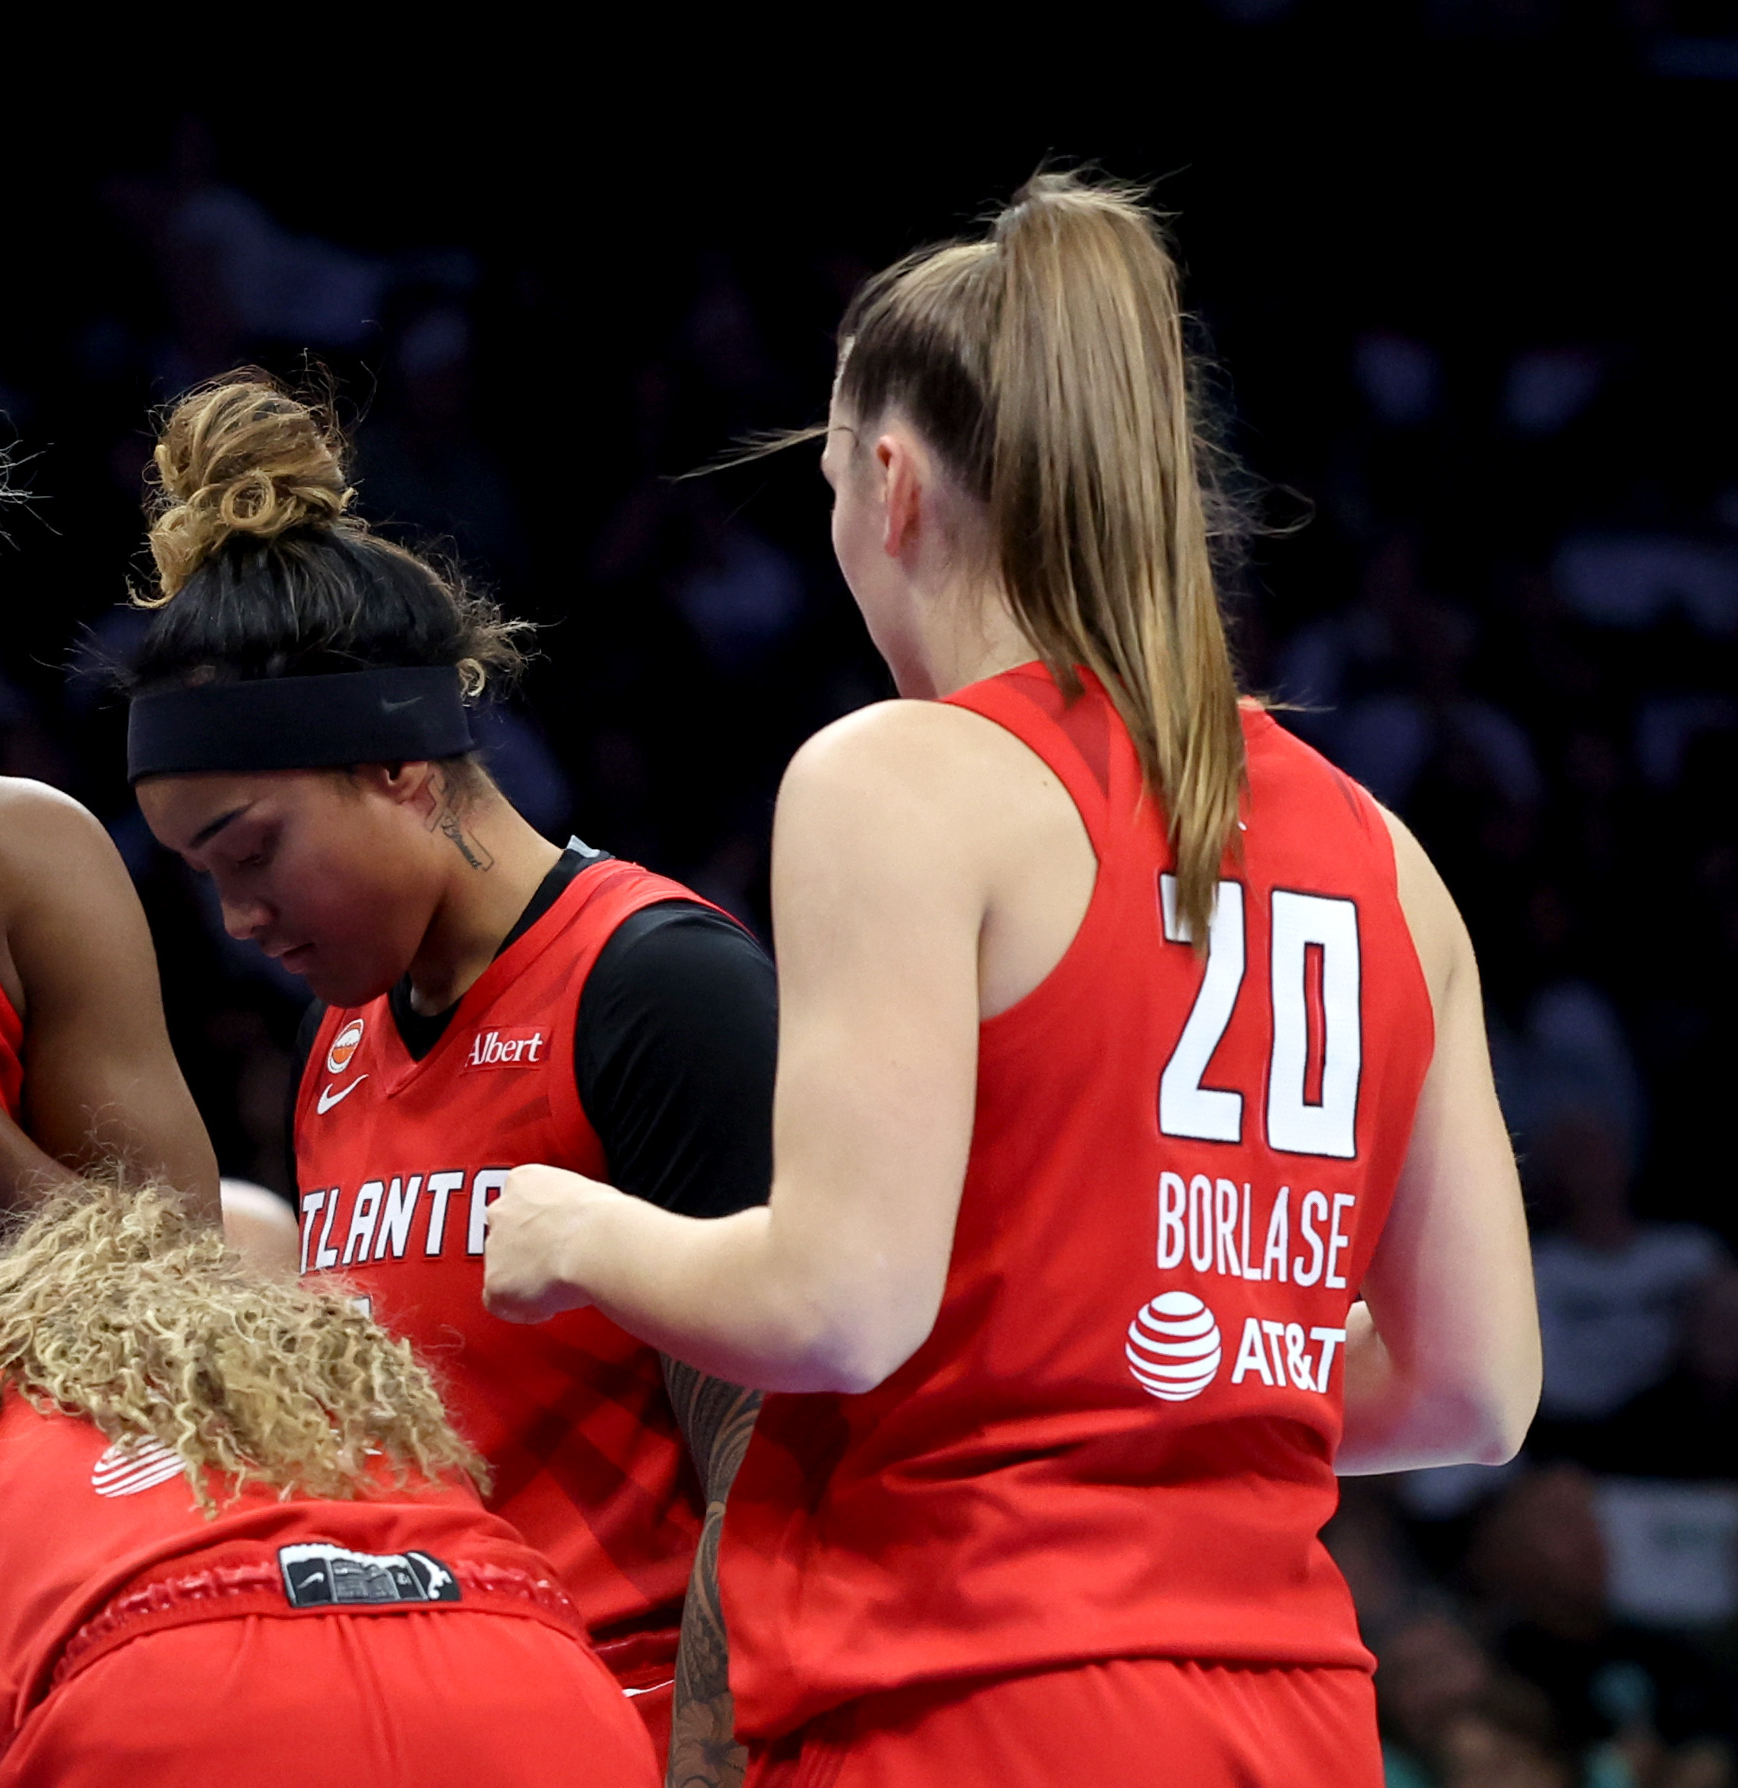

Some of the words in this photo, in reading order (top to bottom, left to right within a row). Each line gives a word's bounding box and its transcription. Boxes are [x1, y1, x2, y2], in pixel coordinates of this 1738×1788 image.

[464, 1031, 543, 1068] Albert
[1159, 873, 1361, 1159] 20
[300, 1169, 512, 1275] TLANTA
[1157, 1172, 1355, 1289] BORLASE
[1231, 1317, 1346, 1393] AT&T
